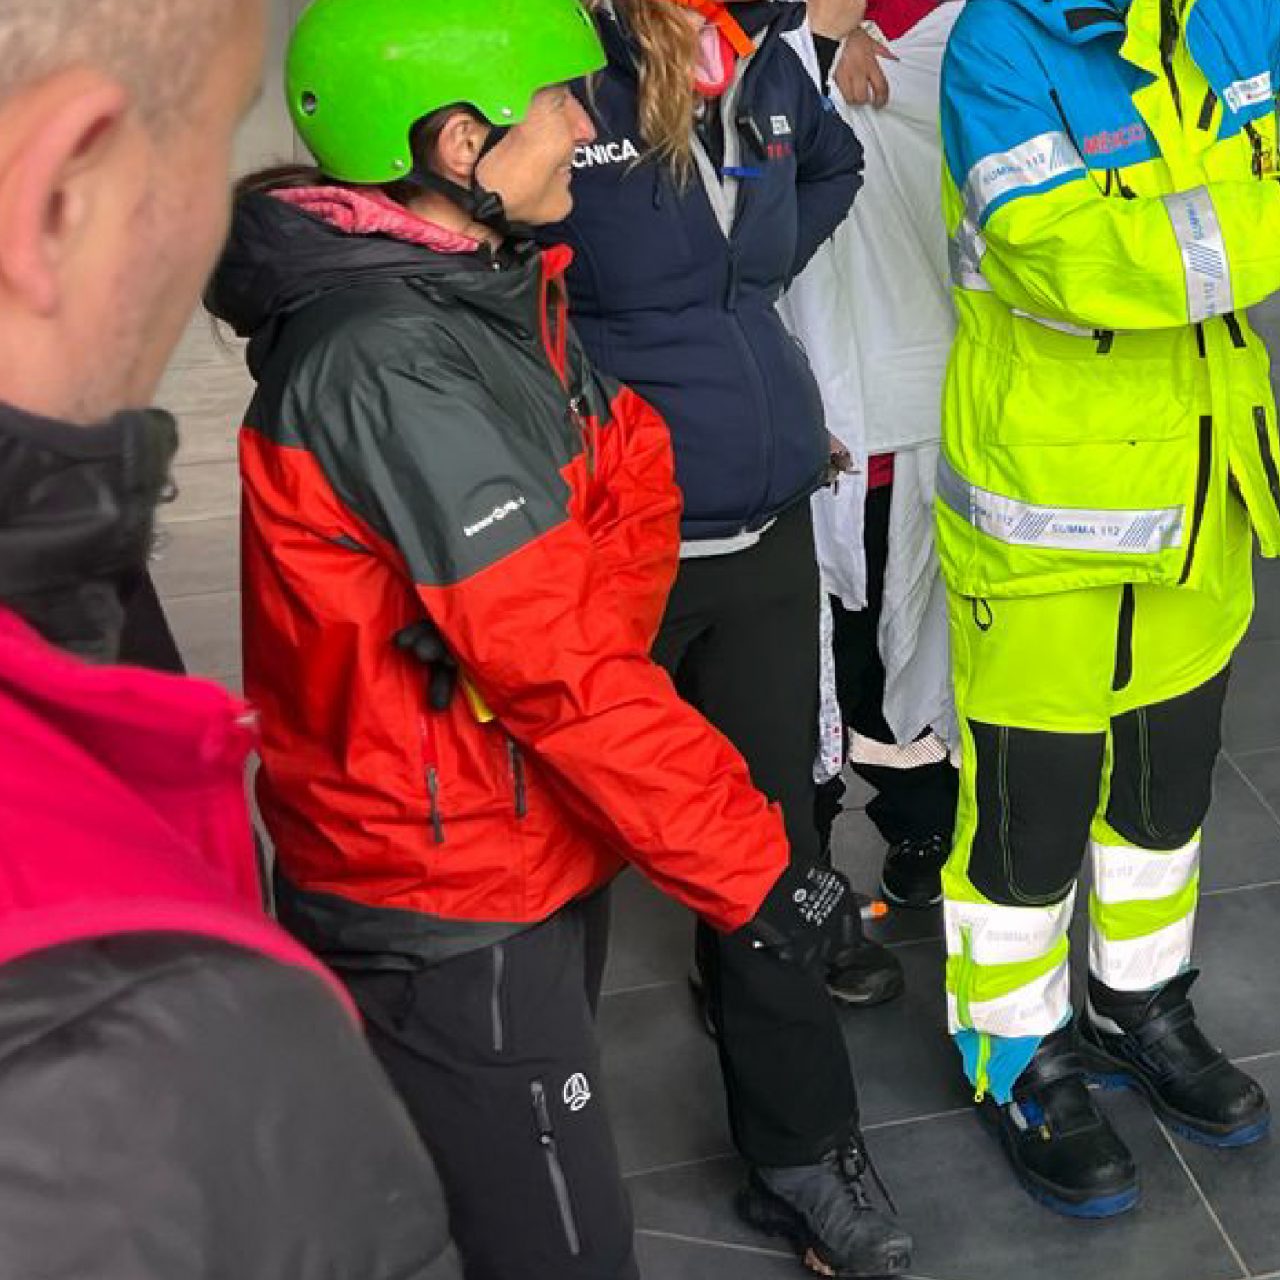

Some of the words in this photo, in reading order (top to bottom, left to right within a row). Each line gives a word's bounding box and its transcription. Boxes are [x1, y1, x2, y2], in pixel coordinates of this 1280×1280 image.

[571, 139, 640, 167] CNICA
[1050, 522, 1096, 536] SUMMA
[1100, 524, 1120, 537] 112
